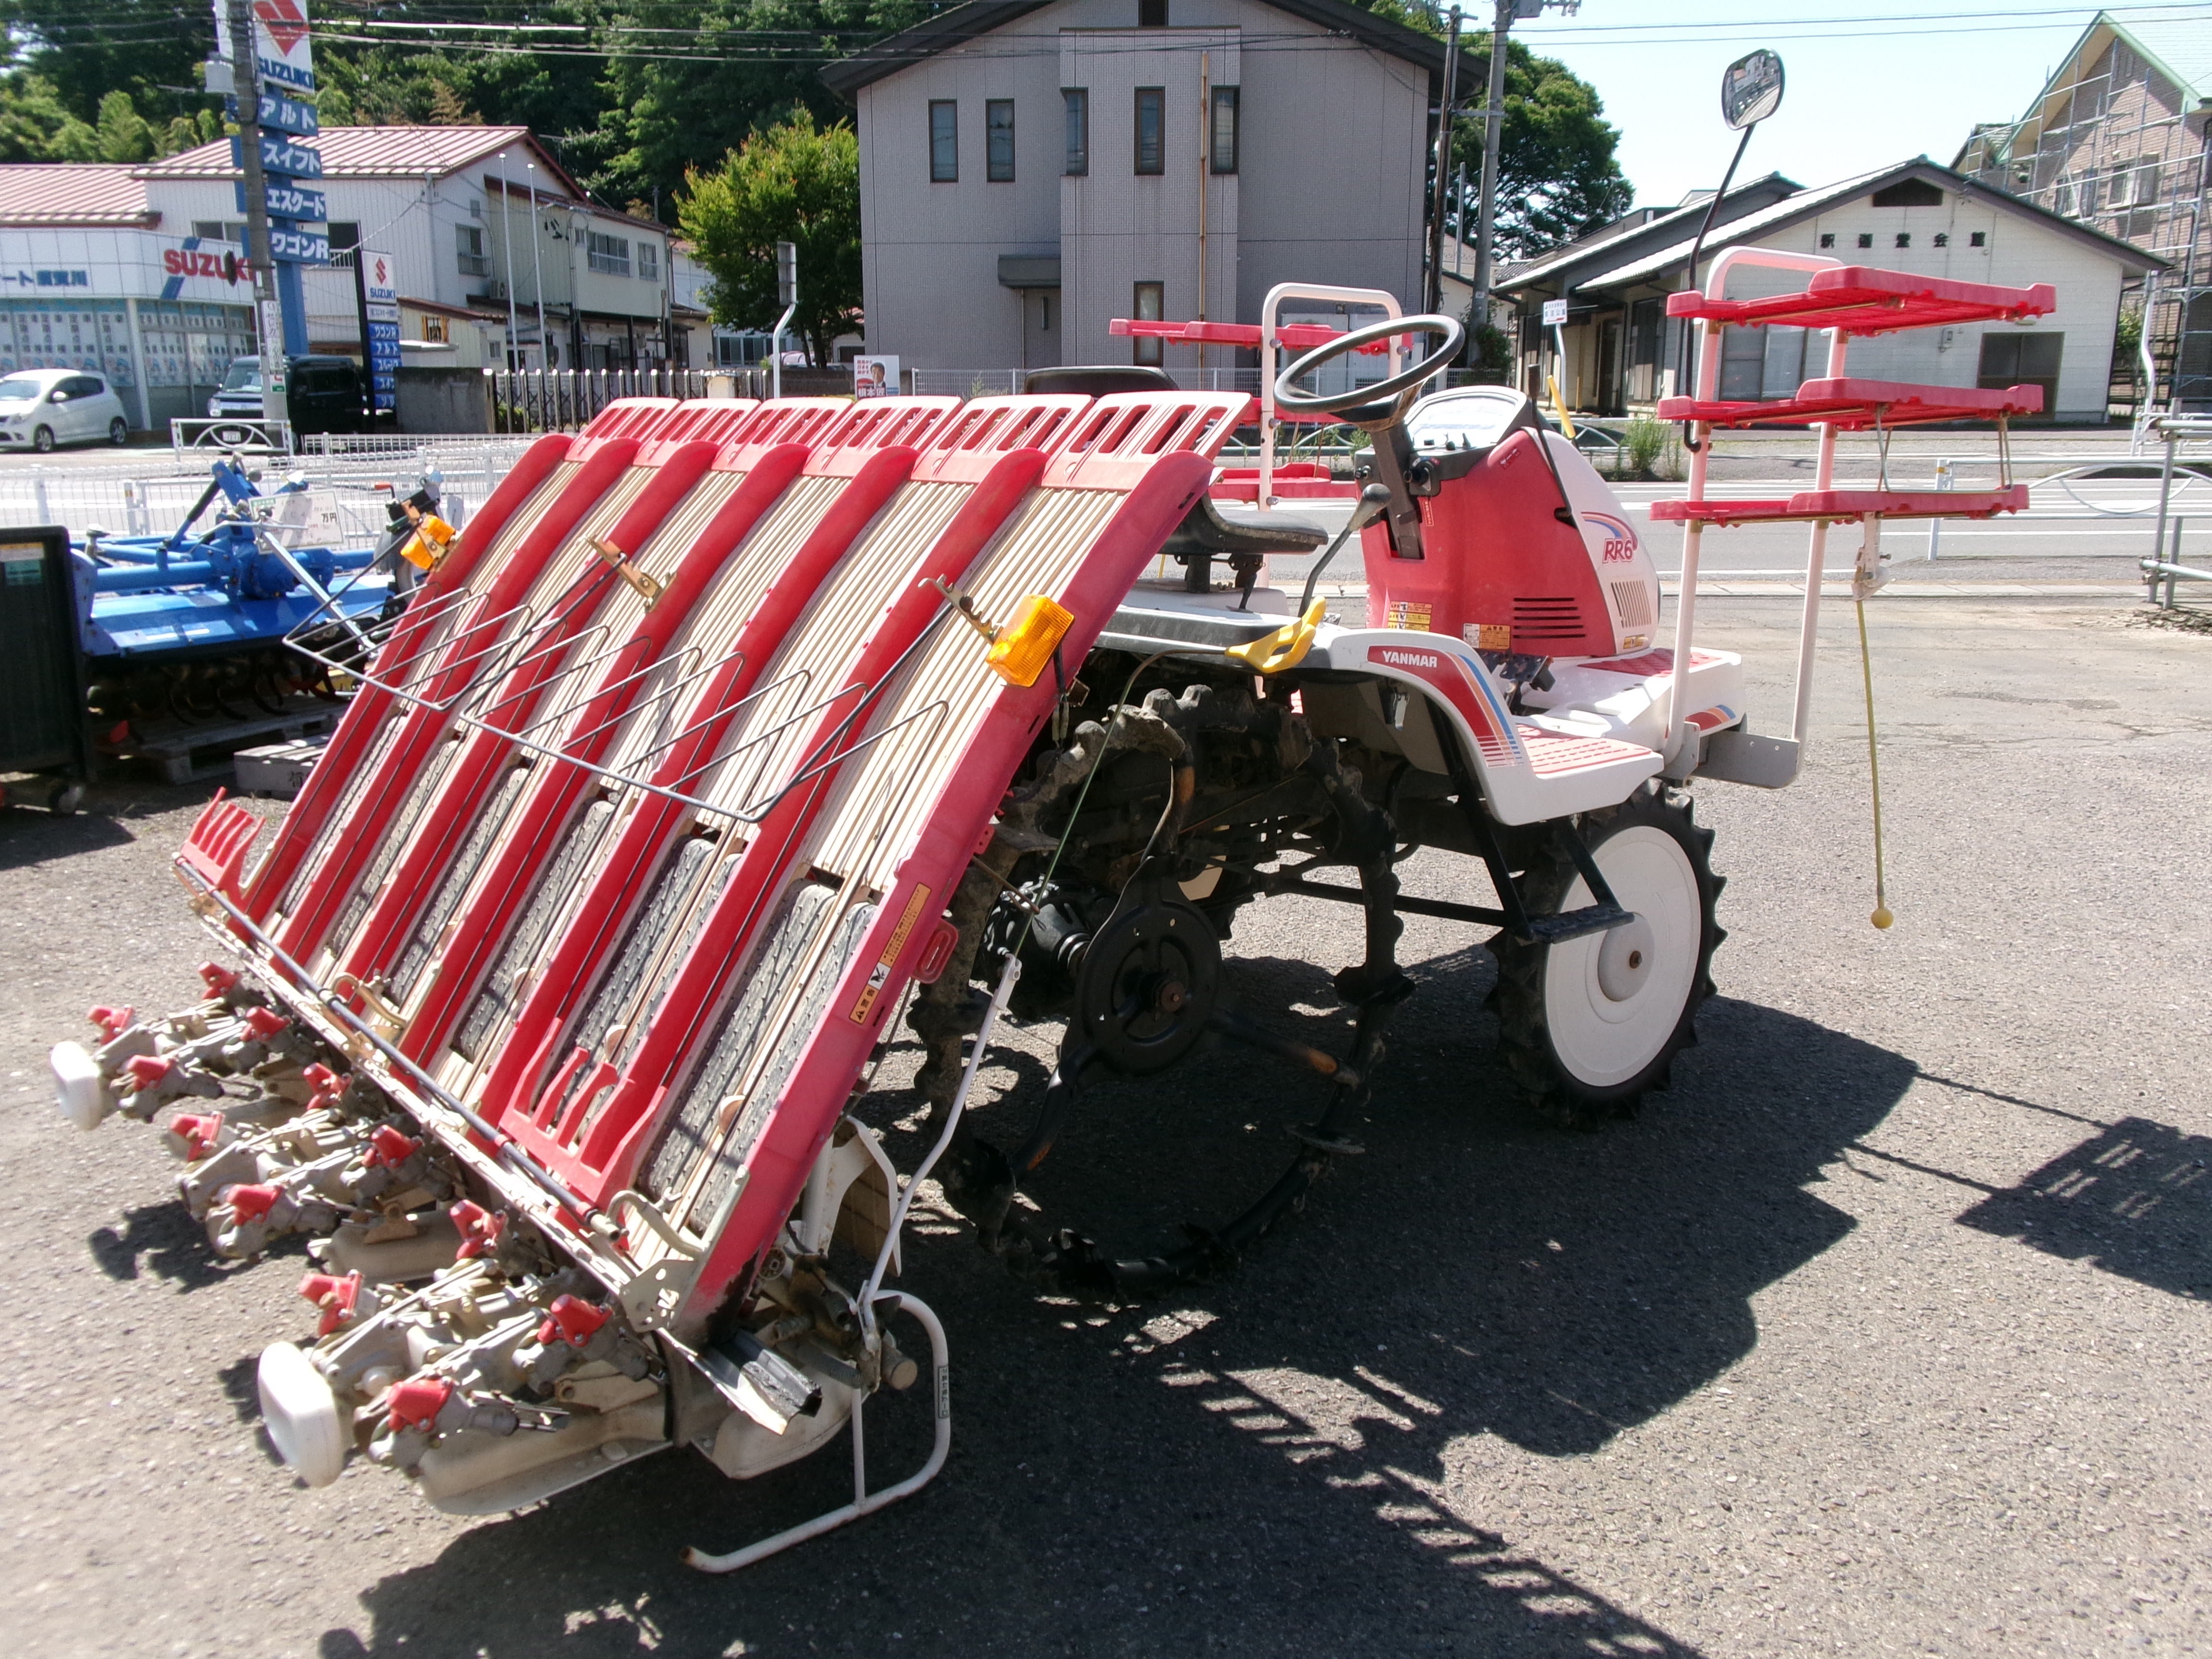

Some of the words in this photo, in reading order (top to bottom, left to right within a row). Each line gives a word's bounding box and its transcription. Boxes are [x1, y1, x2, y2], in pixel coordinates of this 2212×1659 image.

[259, 57, 313, 88] SUZUKI
[261, 97, 315, 130] アルト
[264, 143, 320, 173] スイフト
[267, 188, 325, 217] エスクード
[272, 232, 329, 260] ワゴンR
[164, 249, 253, 281] SUZUKI
[370, 288, 396, 299] SUZUKI
[374, 326, 397, 338] ワゴンR
[376, 342, 398, 355] アルト
[321, 512, 337, 523] 万円
[1603, 538, 1634, 563] RR6
[1382, 650, 1437, 668] YANMAR
